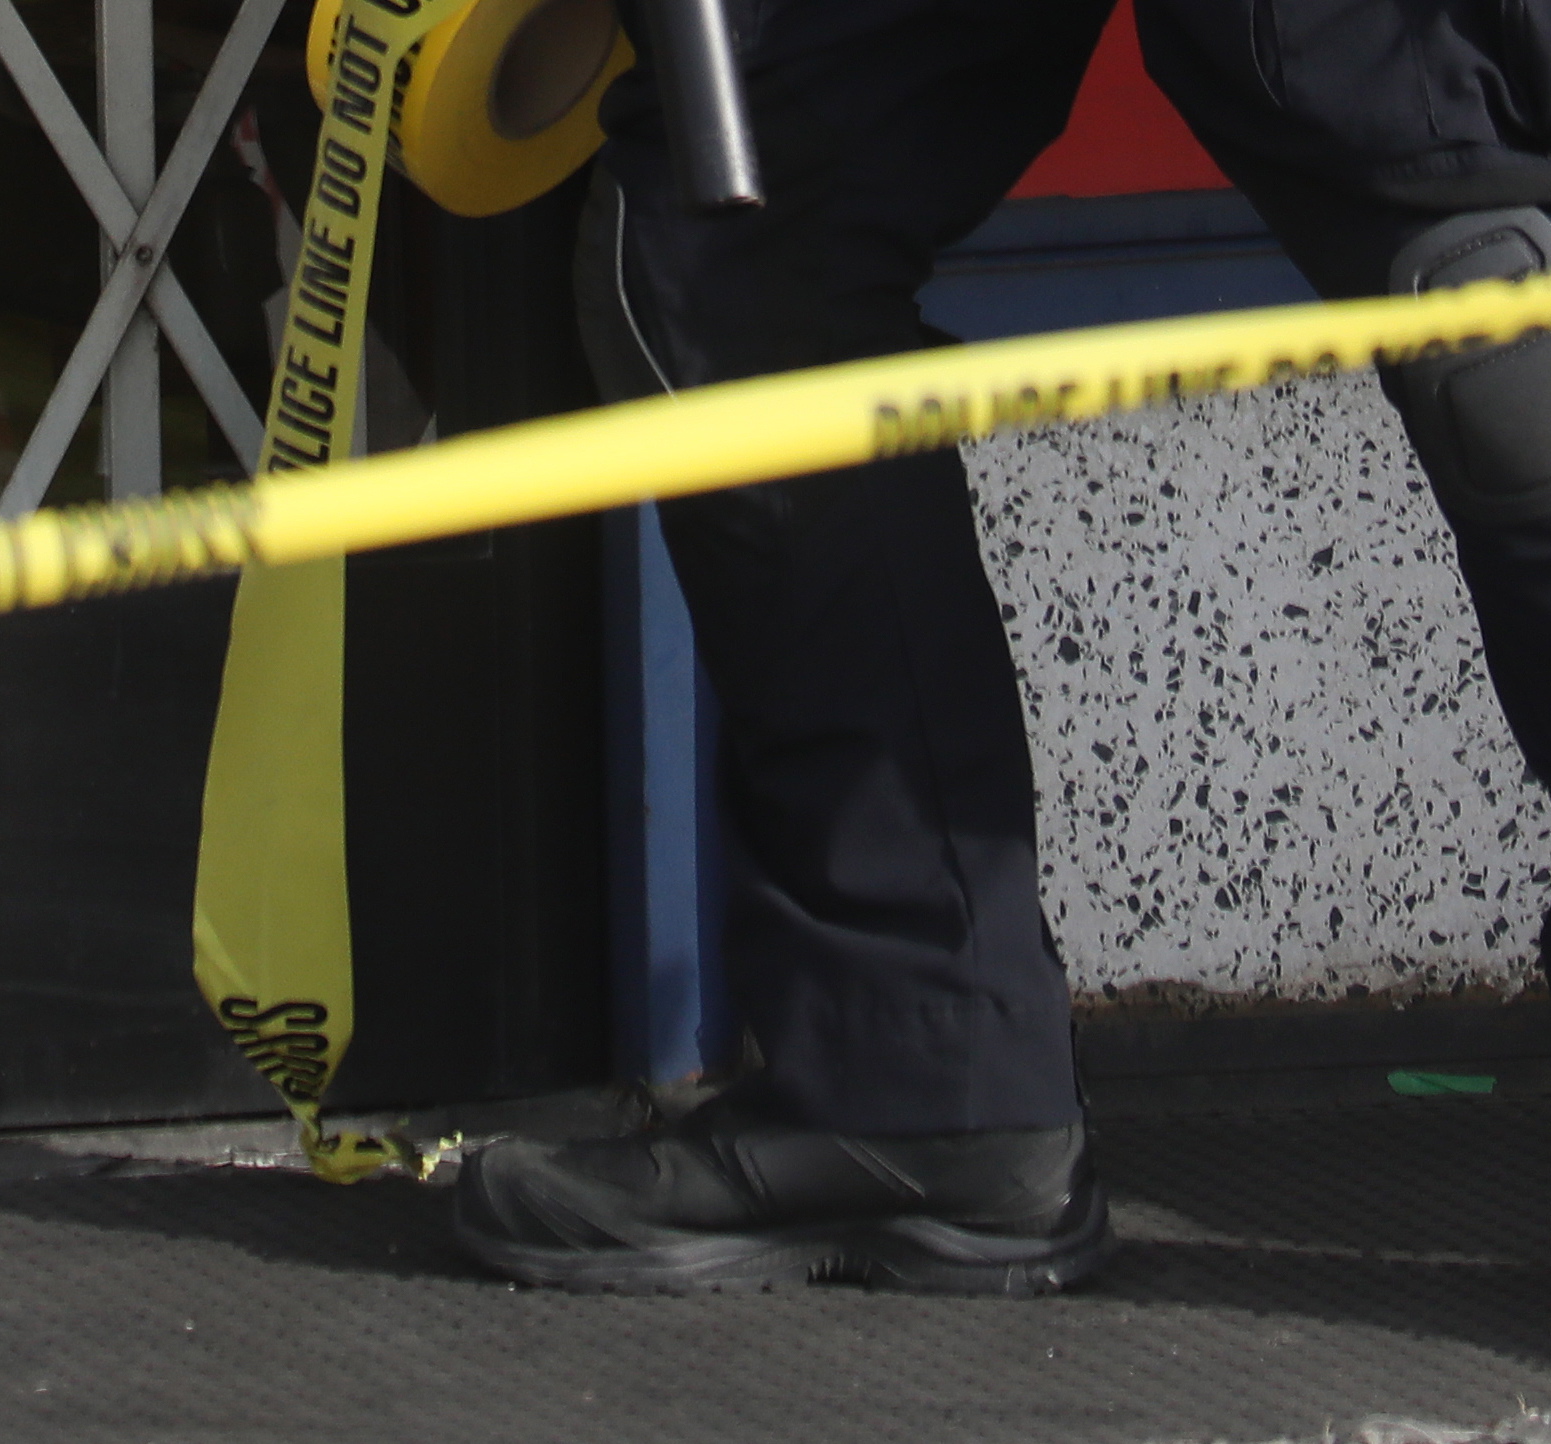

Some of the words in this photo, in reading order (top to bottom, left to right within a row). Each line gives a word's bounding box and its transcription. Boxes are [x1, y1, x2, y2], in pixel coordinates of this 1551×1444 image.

[333, 15, 391, 135] NOT
[316, 138, 368, 219] DO
[294, 217, 357, 349] LINE
